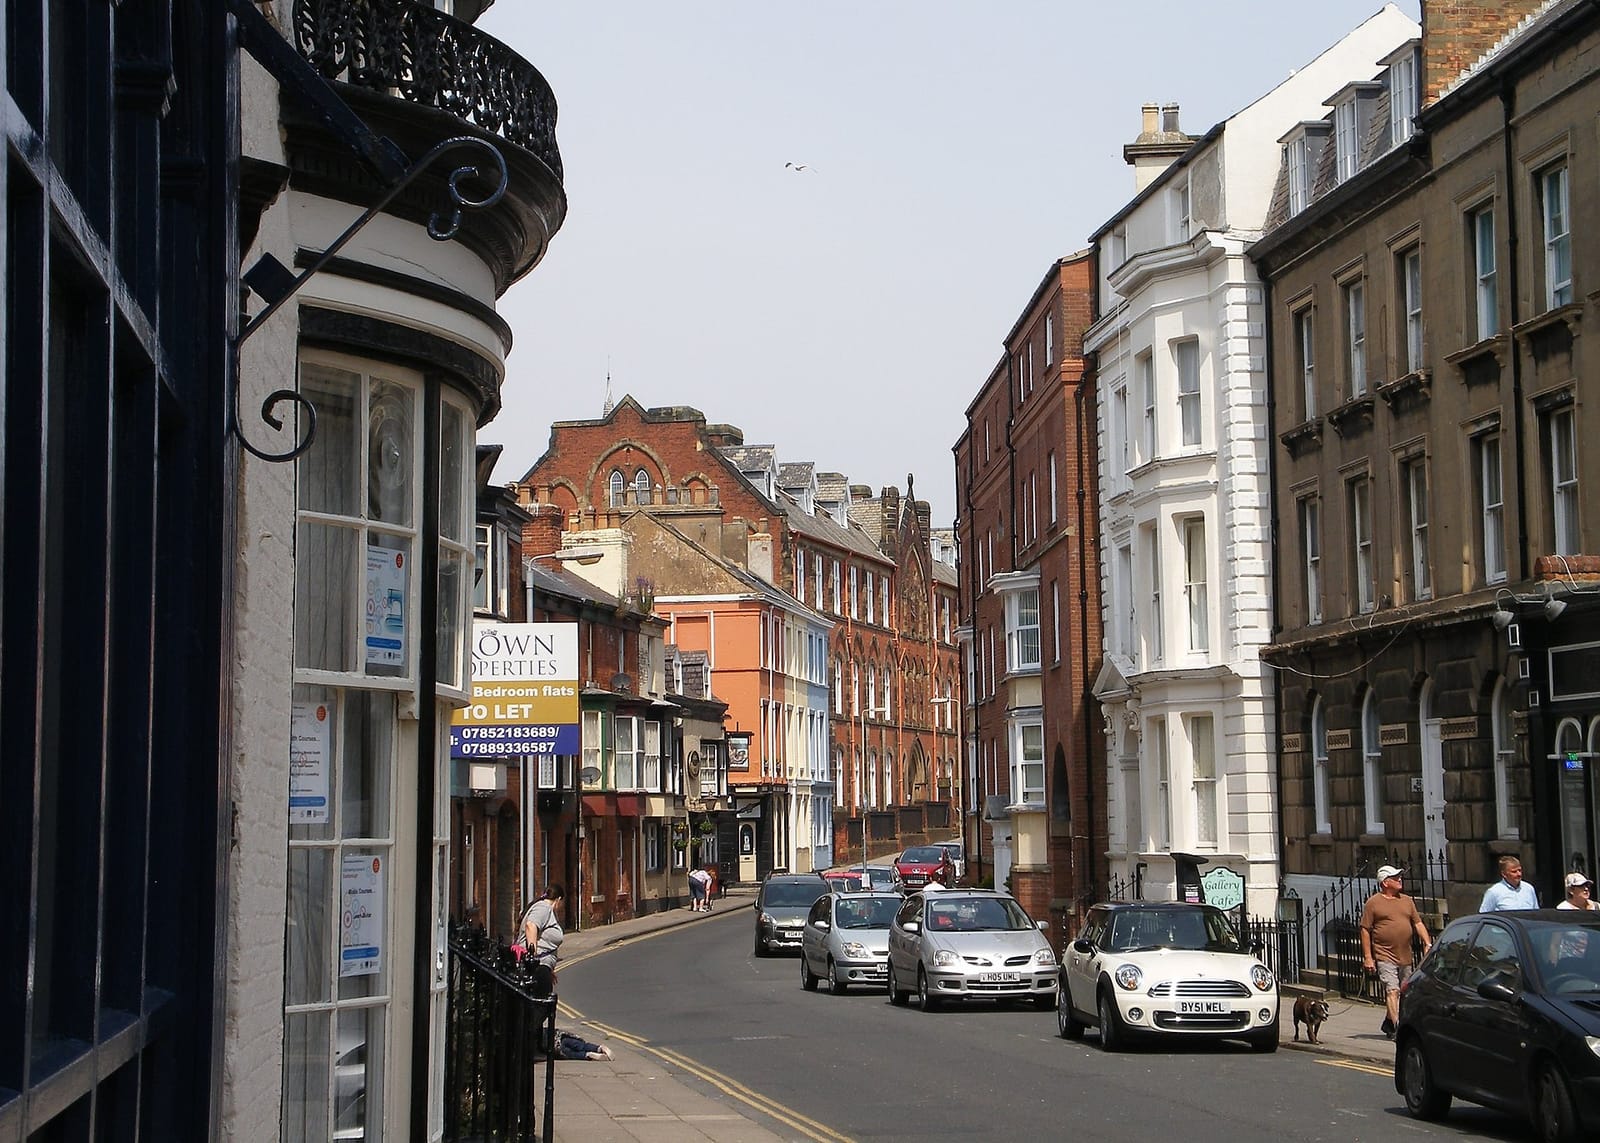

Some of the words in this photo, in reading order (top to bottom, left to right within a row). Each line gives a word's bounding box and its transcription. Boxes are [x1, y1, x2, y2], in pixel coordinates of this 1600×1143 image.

[472, 633, 555, 660] OWN
[473, 686, 538, 697] Bedroom
[542, 685, 575, 697] flats
[462, 704, 488, 720] TO
[494, 703, 533, 720] LET
[462, 726, 560, 739] 07852183689/
[462, 741, 555, 754] 07889336587
[1204, 879, 1240, 893] Gallery
[1211, 894, 1234, 908] Cafe
